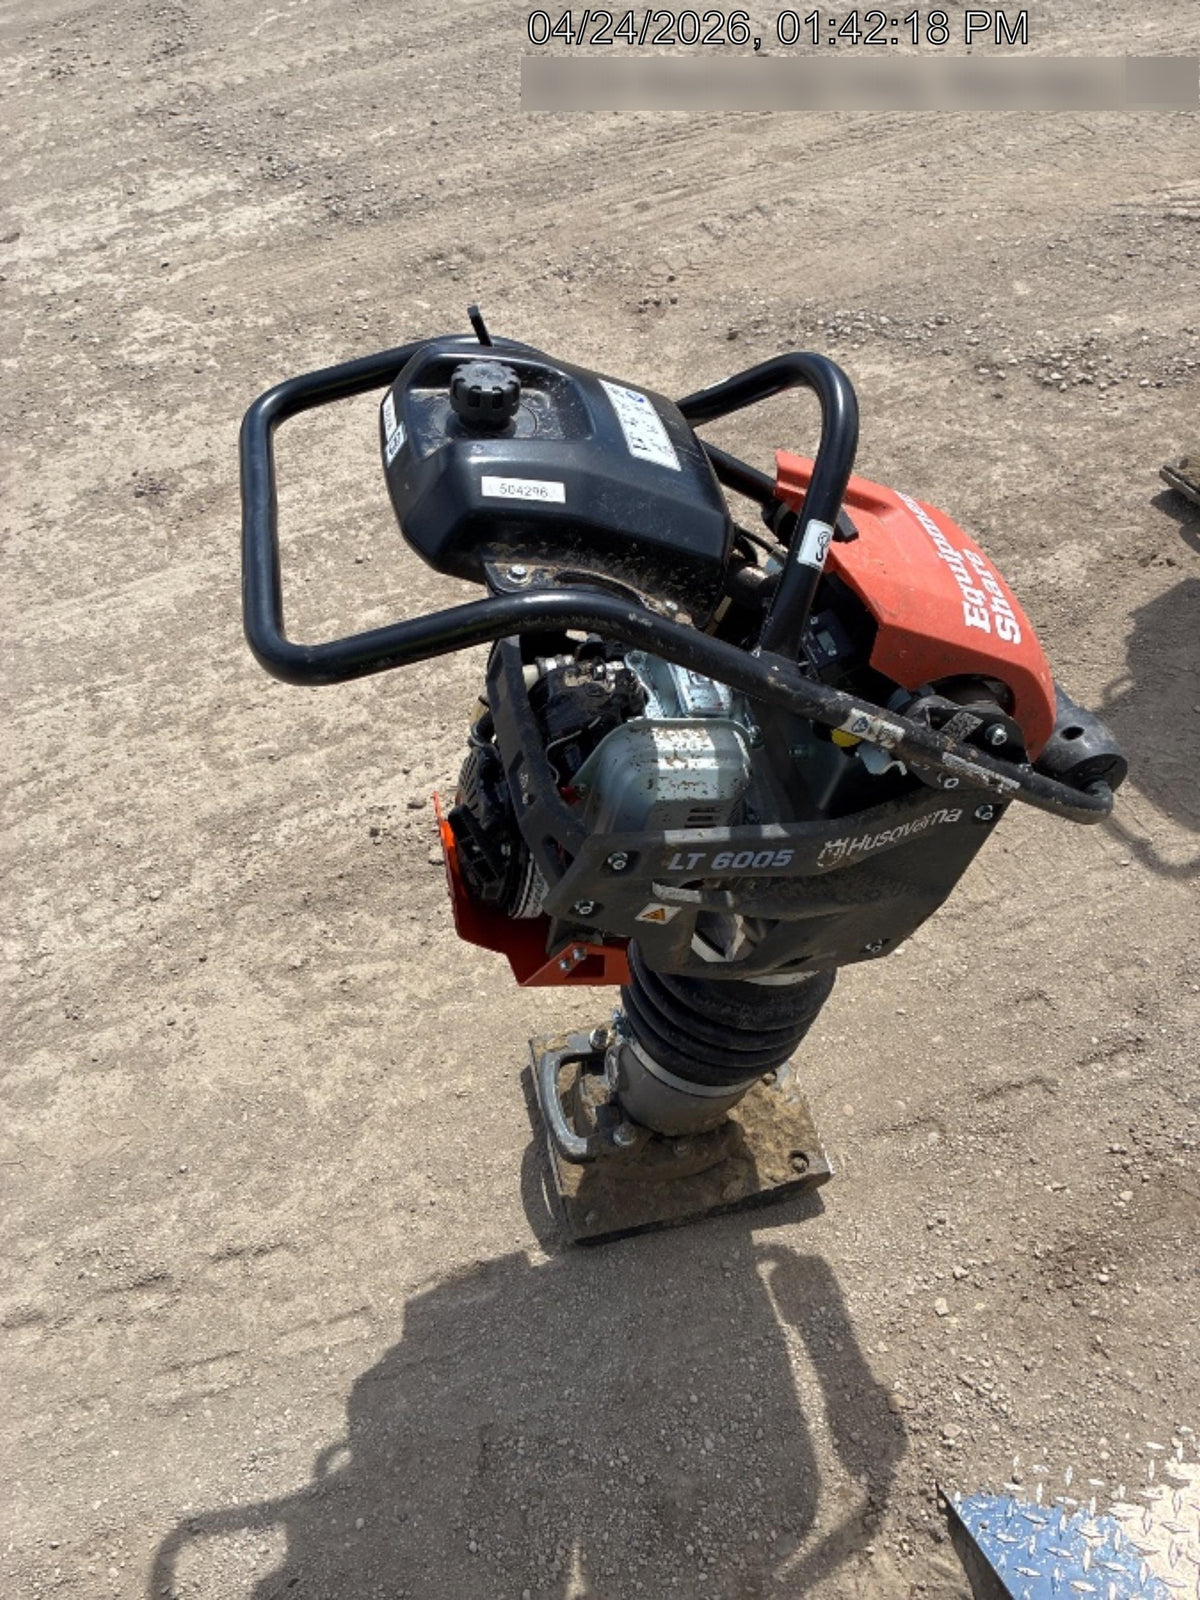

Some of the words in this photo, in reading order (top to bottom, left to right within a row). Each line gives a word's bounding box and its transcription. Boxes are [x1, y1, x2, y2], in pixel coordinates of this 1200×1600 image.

[499, 482, 549, 498] 504296
[964, 549, 1021, 645] Share
[668, 852, 707, 870] LT
[711, 849, 795, 870] 6005
